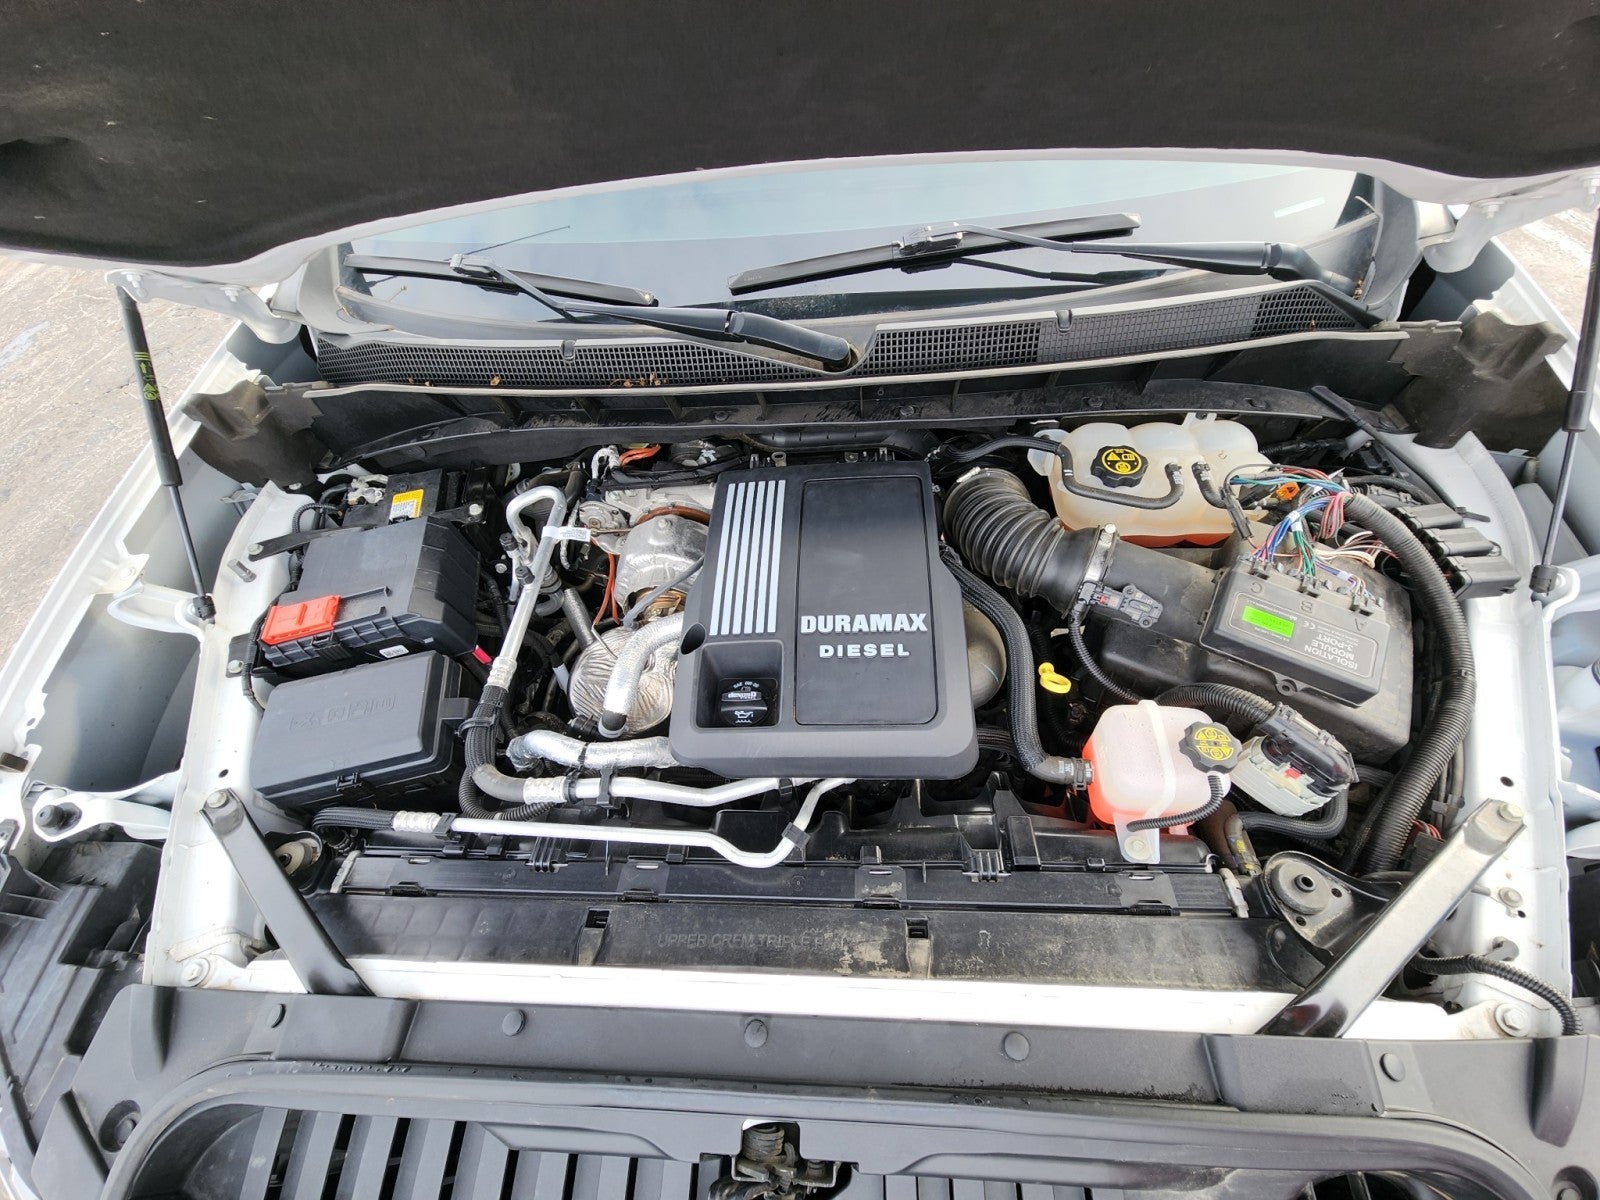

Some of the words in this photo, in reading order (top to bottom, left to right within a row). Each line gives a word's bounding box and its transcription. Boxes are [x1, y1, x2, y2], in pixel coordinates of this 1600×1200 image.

[800, 613, 927, 634] DURAMAX
[819, 643, 910, 659] DIESEL
[1311, 639, 1355, 660] MODULE
[1315, 633, 1354, 652] 3-PORT
[1304, 644, 1358, 671] ISOLATION
[657, 933, 707, 948] UPPER
